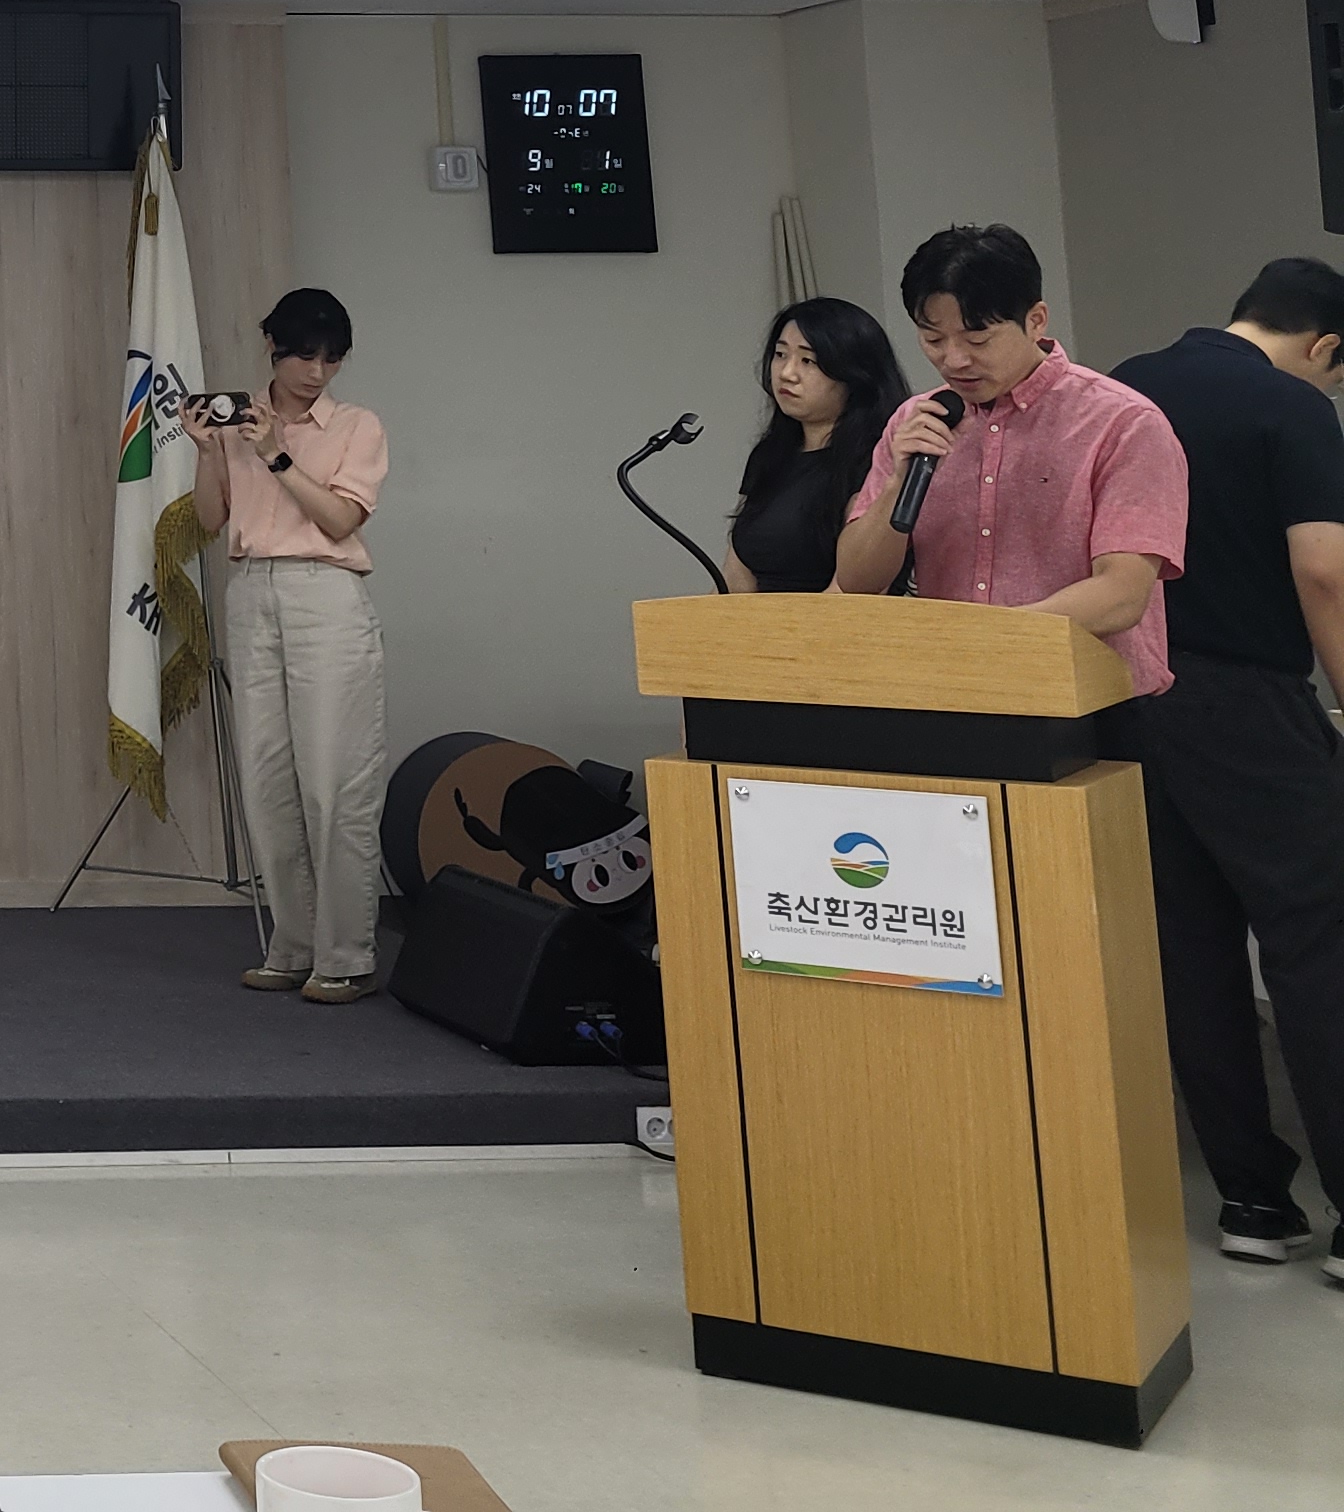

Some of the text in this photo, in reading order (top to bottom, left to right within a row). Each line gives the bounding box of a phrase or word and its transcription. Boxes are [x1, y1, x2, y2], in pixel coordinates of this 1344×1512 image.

[524, 89, 551, 117] 10
[579, 89, 617, 117] 07
[767, 891, 966, 939] 축산환경관리원
[769, 923, 967, 951] Livestock Environmental Management Institute
